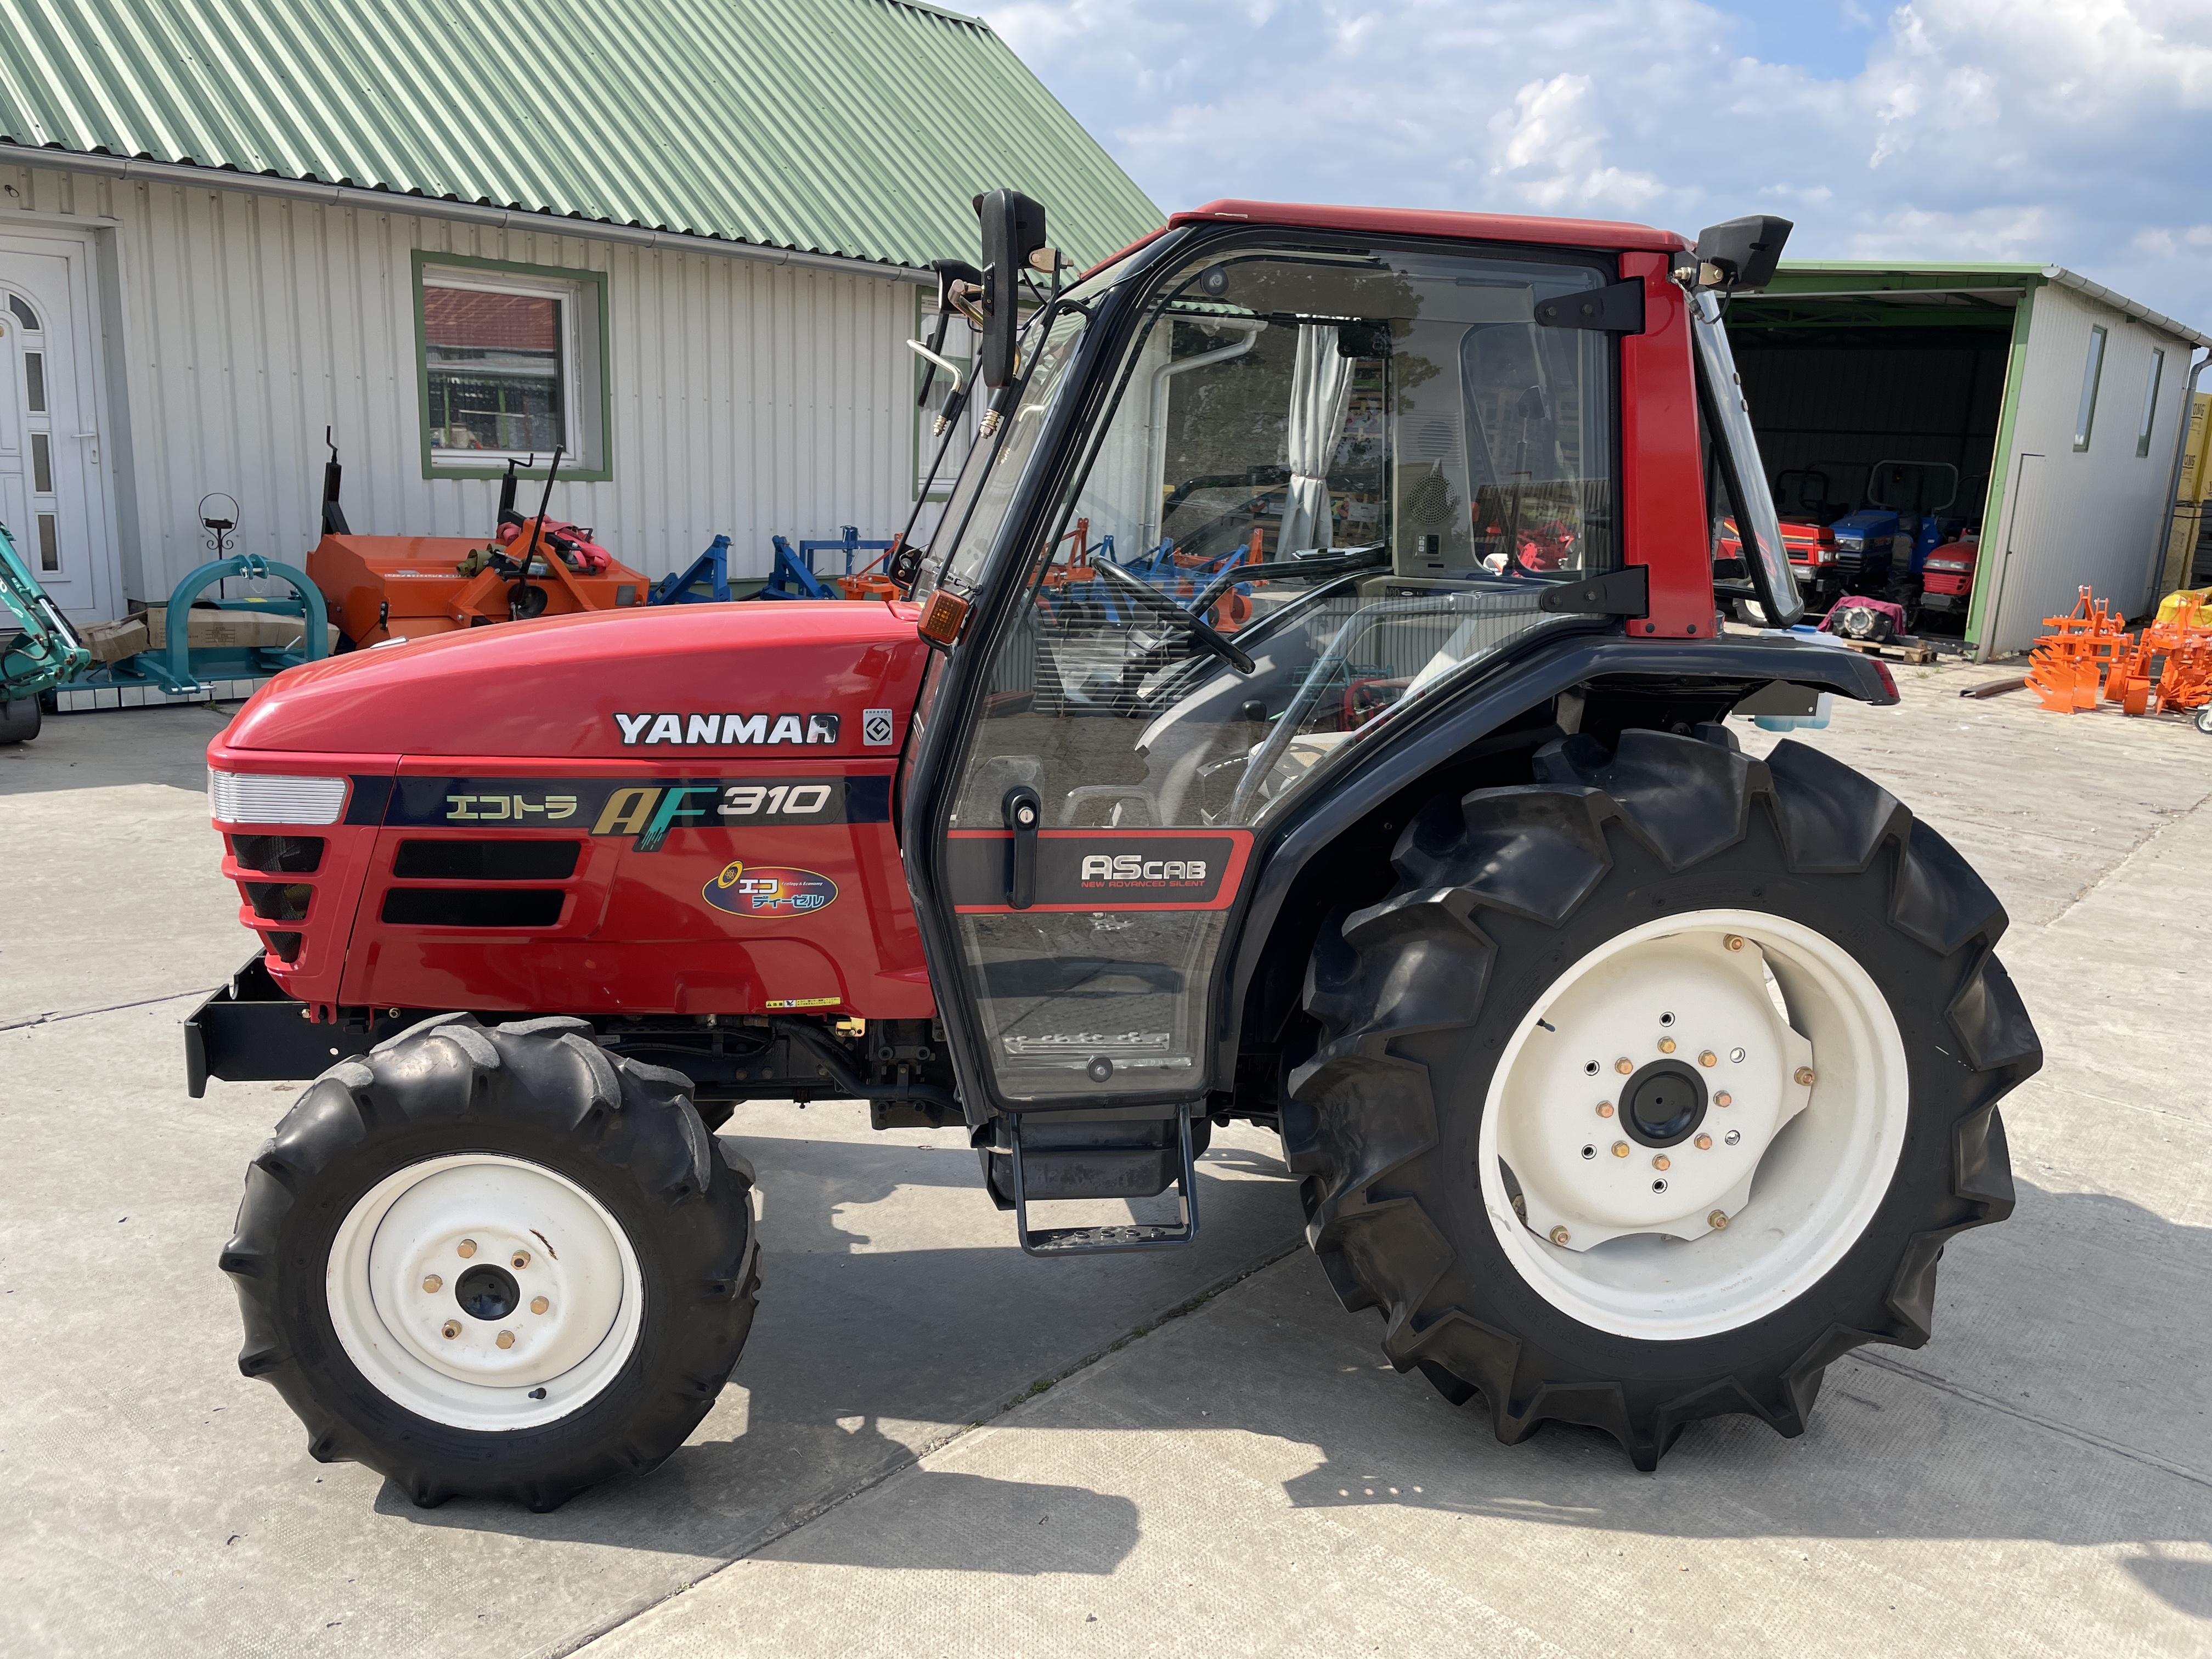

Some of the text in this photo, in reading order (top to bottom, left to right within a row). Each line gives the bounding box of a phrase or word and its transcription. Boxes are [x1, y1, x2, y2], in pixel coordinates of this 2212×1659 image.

[615, 714, 839, 744] YANMAR
[446, 794, 577, 819] エコトラ
[738, 879, 778, 894] エコ
[752, 894, 825, 909] ディーゼル
